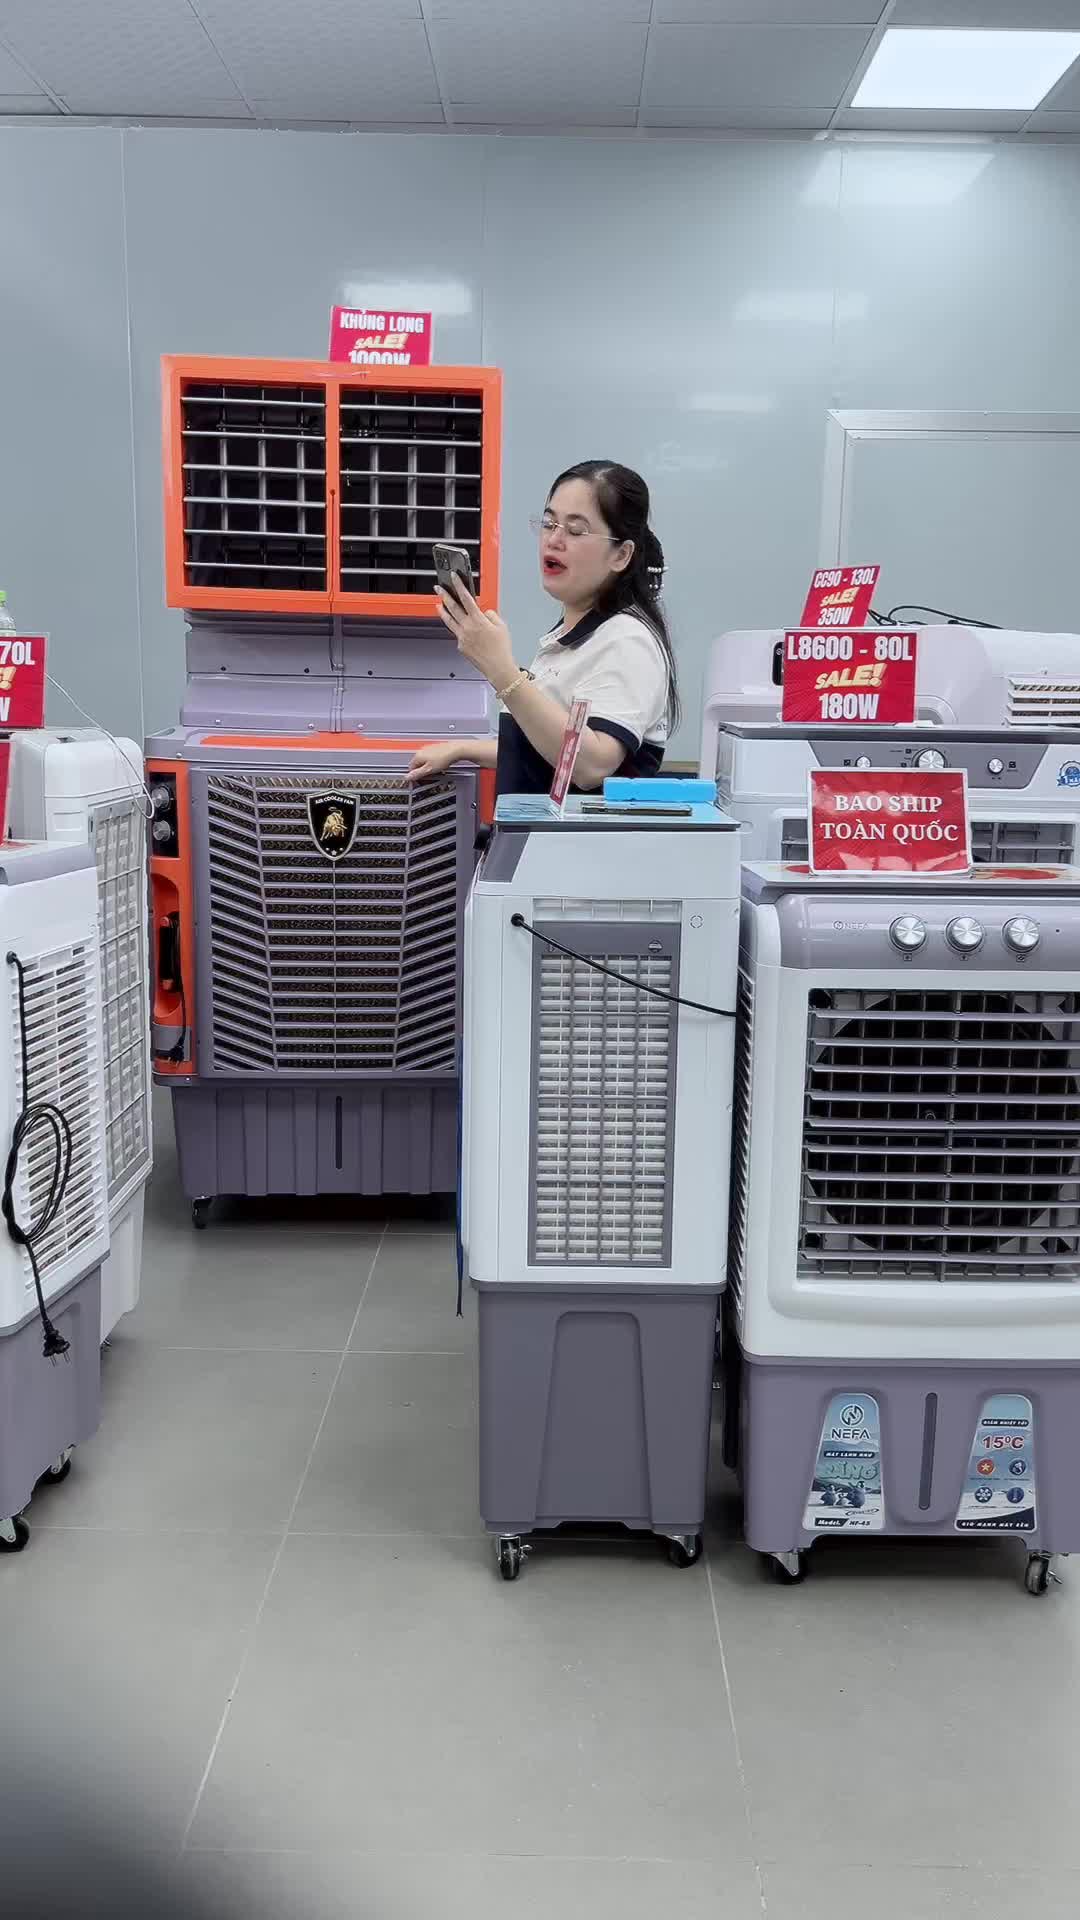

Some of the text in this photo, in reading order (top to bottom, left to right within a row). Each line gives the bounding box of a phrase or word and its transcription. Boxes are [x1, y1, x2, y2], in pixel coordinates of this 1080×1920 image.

[340, 309, 424, 333] KHỦNG LONG
[353, 333, 409, 350] SALE!
[348, 350, 411, 365] 1000W
[850, 567, 876, 586] 130L
[820, 586, 860, 607] SALE!
[817, 606, 854, 626] 350W
[787, 635, 853, 661] L8600
[874, 635, 913, 661] 80L
[815, 662, 888, 690] SALE!
[818, 692, 880, 720] 180W
[834, 794, 943, 813] BAO SHIP
[820, 818, 959, 845] TOÀN QUỐC
[831, 1428, 870, 1440] NEFA
